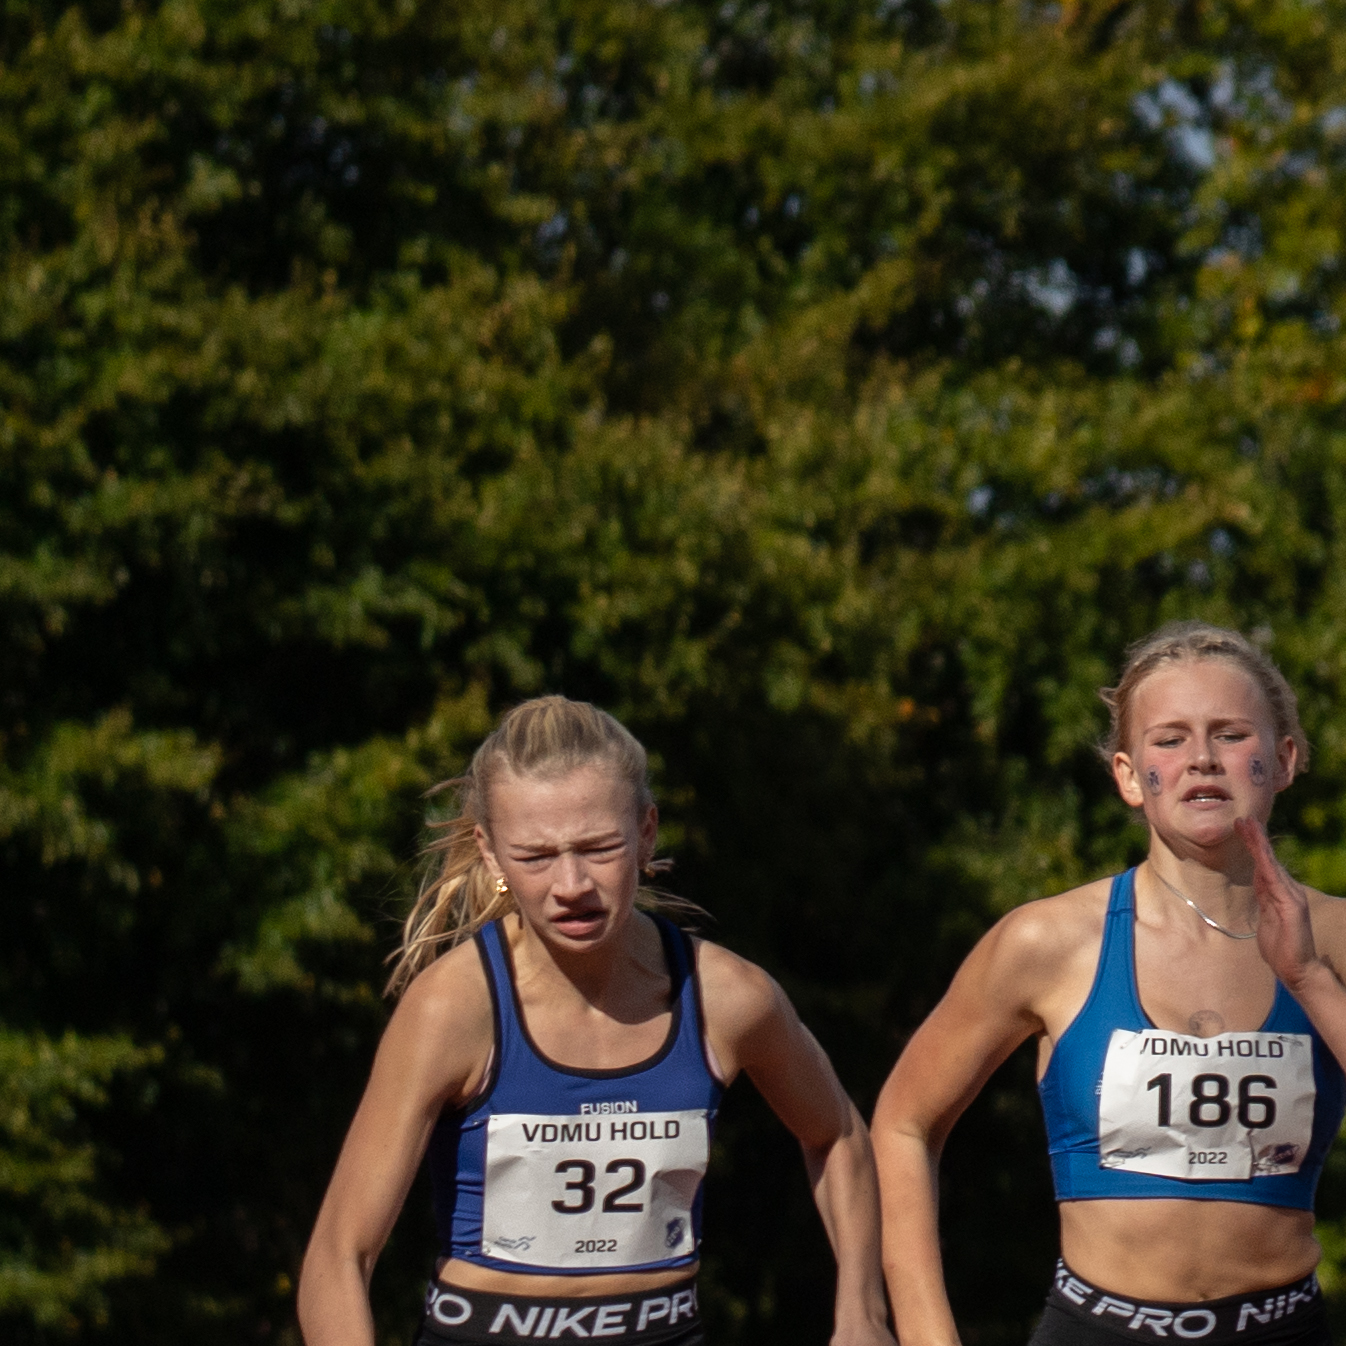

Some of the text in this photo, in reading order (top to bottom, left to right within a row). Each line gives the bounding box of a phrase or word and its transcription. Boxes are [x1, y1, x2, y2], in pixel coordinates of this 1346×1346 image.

[1218, 1040, 1284, 1058] HOLD
[580, 1100, 638, 1116] FUSION
[1147, 1073, 1277, 1129] 186
[522, 1120, 681, 1143] VDMU HOLD
[1188, 1151, 1228, 1165] 2022
[551, 1158, 646, 1214] 32
[574, 1239, 618, 1254] 2022
[488, 1302, 632, 1338] NIKE
[1091, 1296, 1217, 1338] PRO
